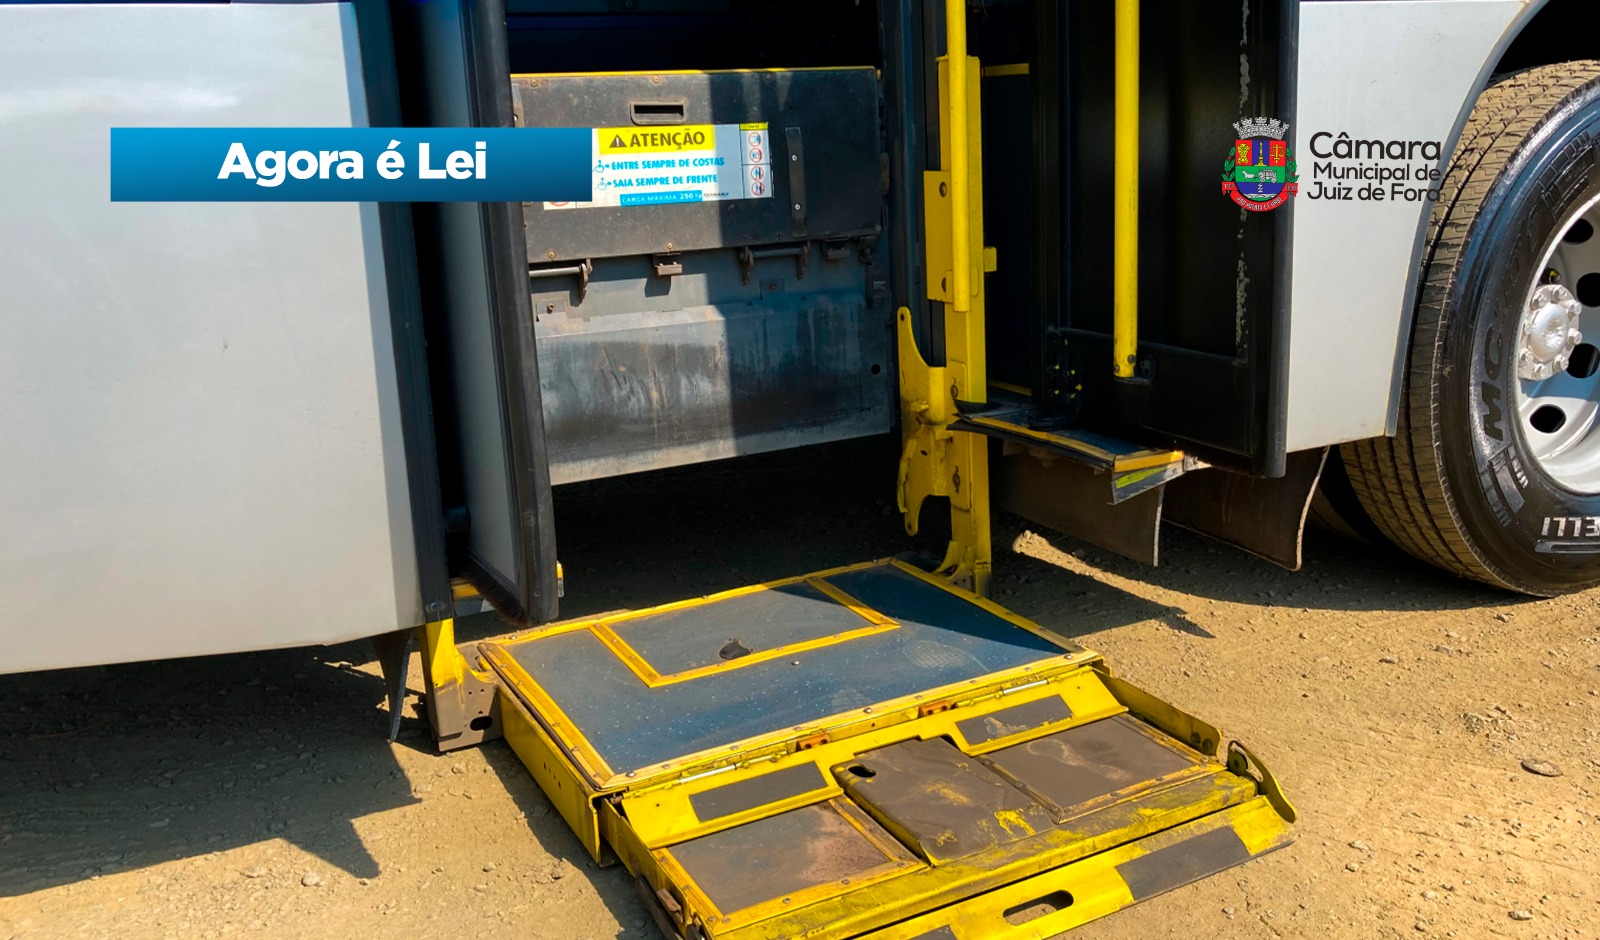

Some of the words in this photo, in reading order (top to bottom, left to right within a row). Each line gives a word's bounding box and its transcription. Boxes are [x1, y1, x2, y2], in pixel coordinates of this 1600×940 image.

[629, 127, 706, 150] ATENÇÃO
[612, 160, 640, 170] ENTRE
[642, 159, 676, 169] SEMPRE
[679, 158, 690, 168] DE
[692, 157, 725, 167] COSTAS
[613, 178, 634, 188] SAIA
[635, 176, 670, 187] SEMPRE
[673, 175, 684, 185] DE
[686, 174, 718, 184] FRENTE
